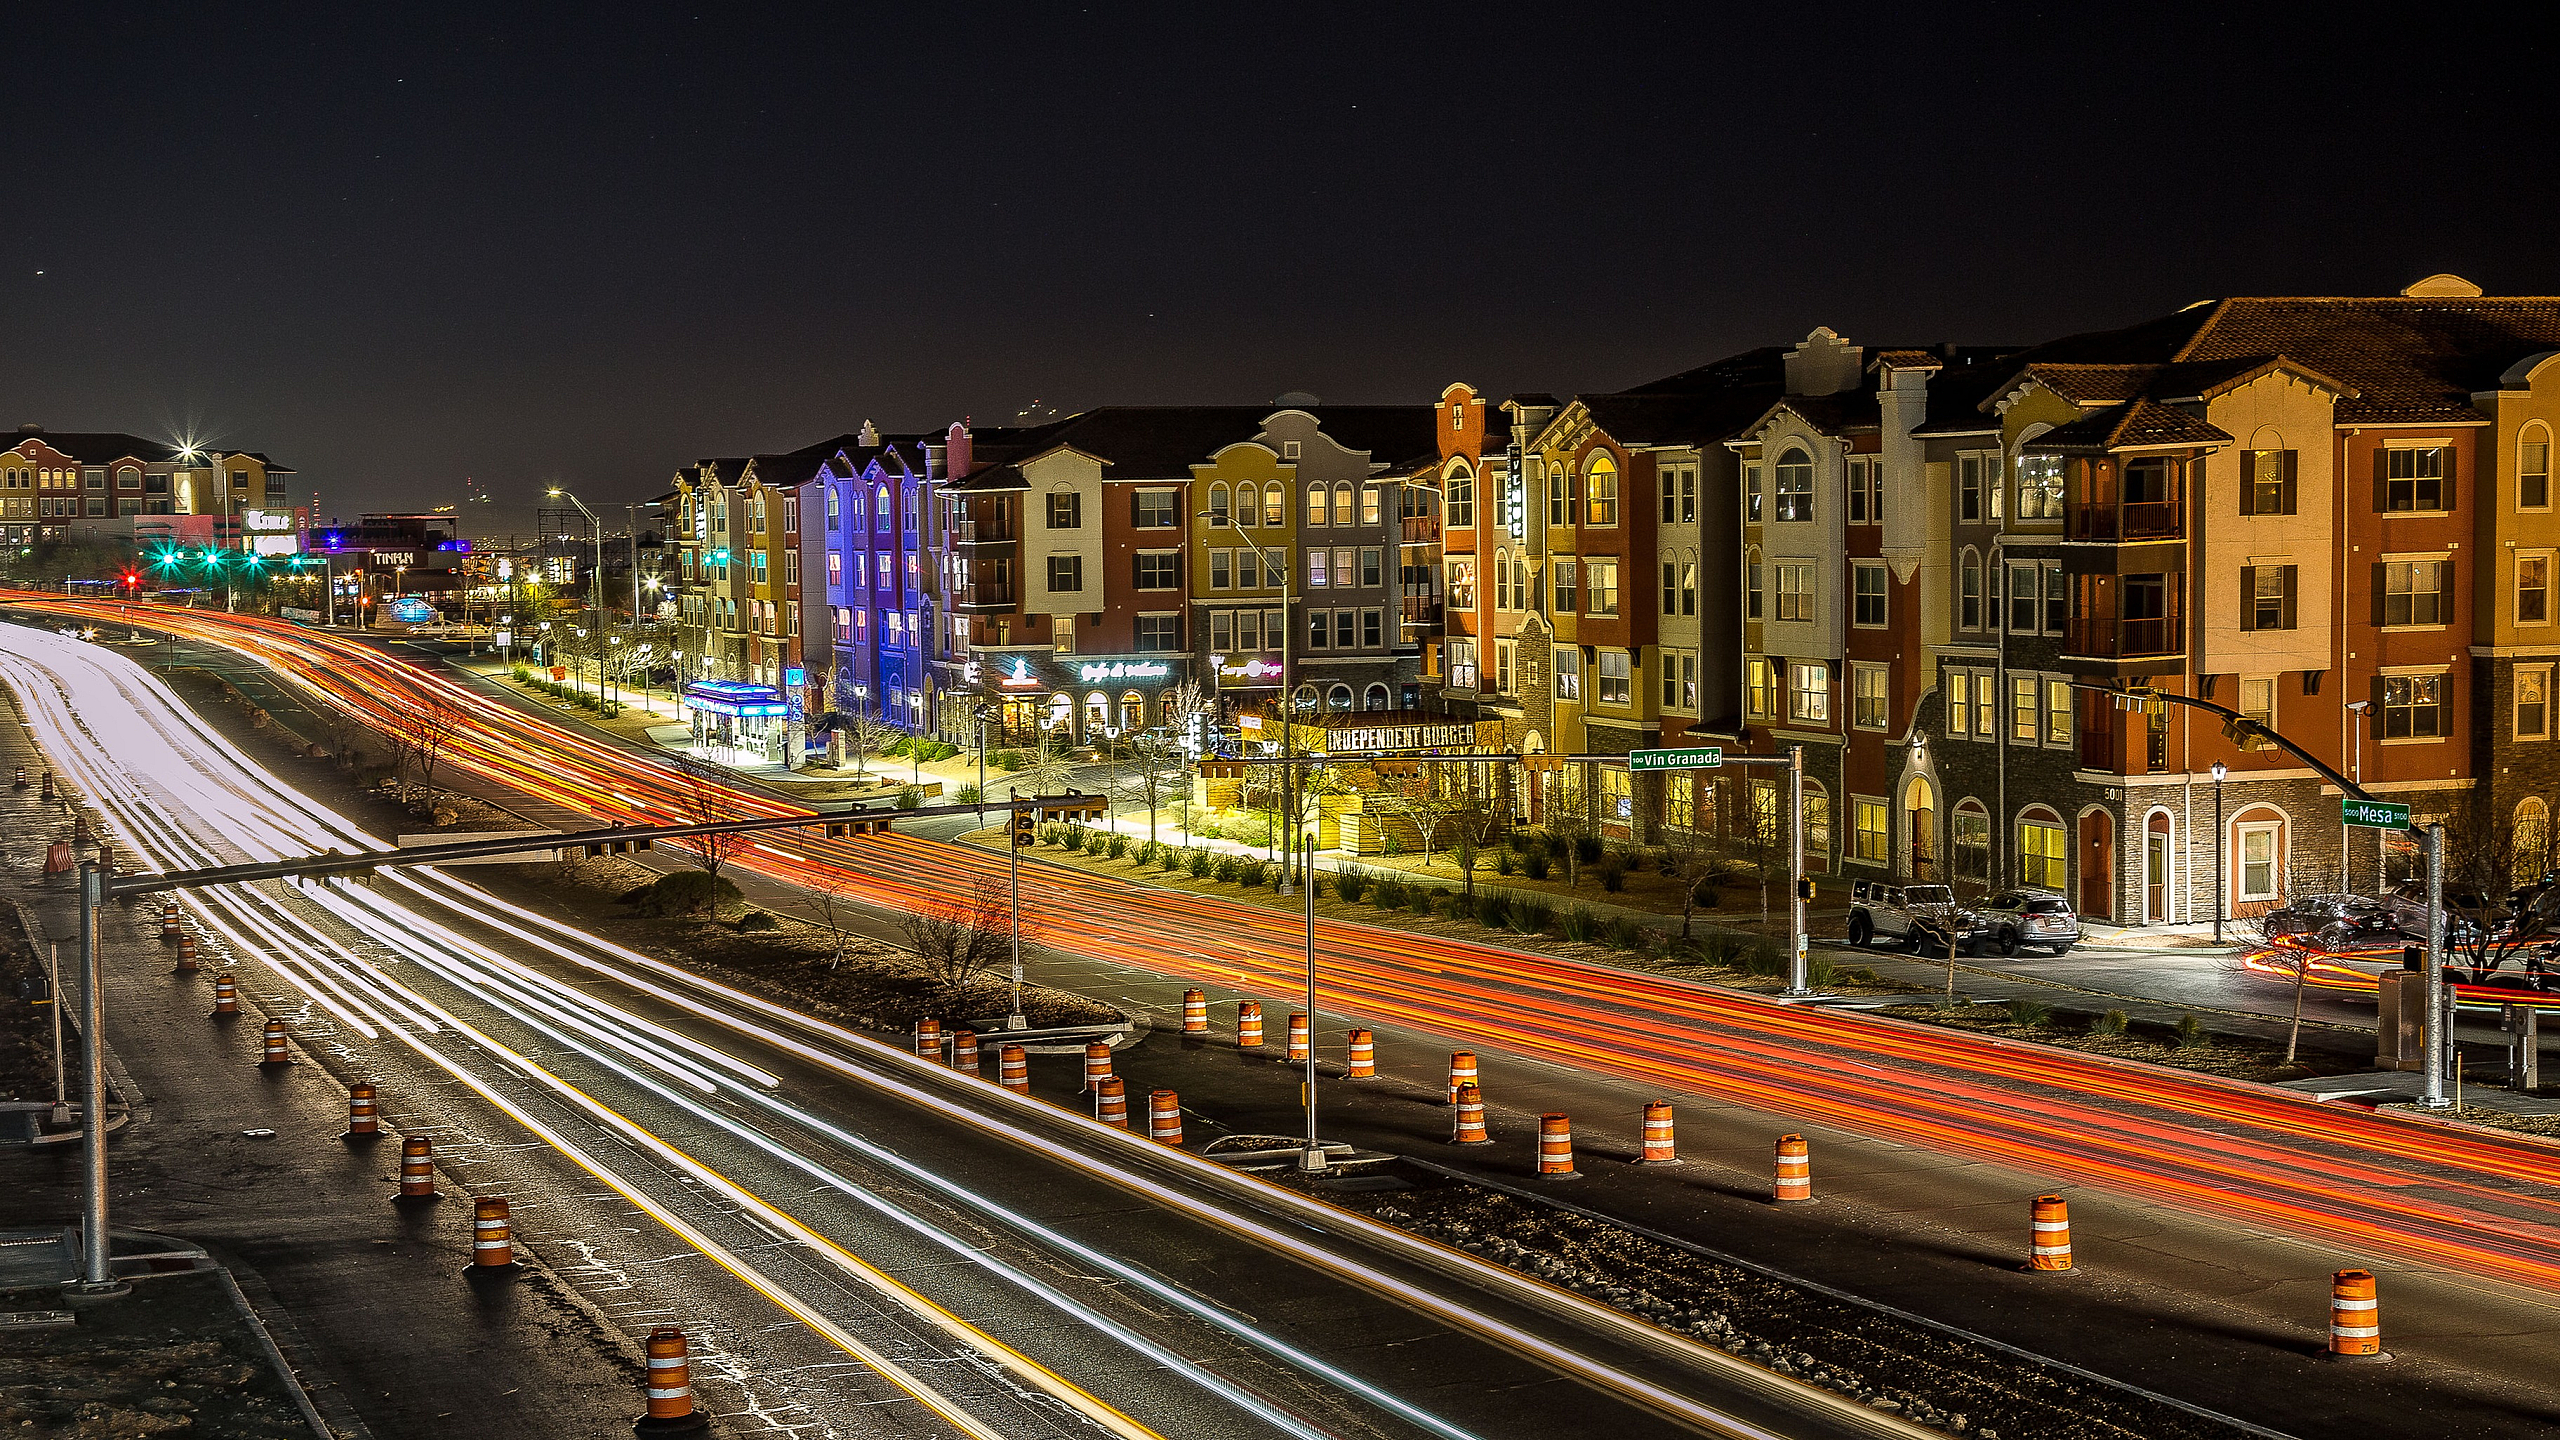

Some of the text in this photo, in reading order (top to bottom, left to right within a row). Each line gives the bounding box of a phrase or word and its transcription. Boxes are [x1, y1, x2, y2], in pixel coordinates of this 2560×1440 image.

[1328, 724, 1475, 751] INDEPENDENT BURGER
[1644, 753, 1665, 766] Vin
[1667, 751, 1720, 766] Granada
[2104, 788, 2123, 801] 5001
[2359, 806, 2393, 824] Mesa
